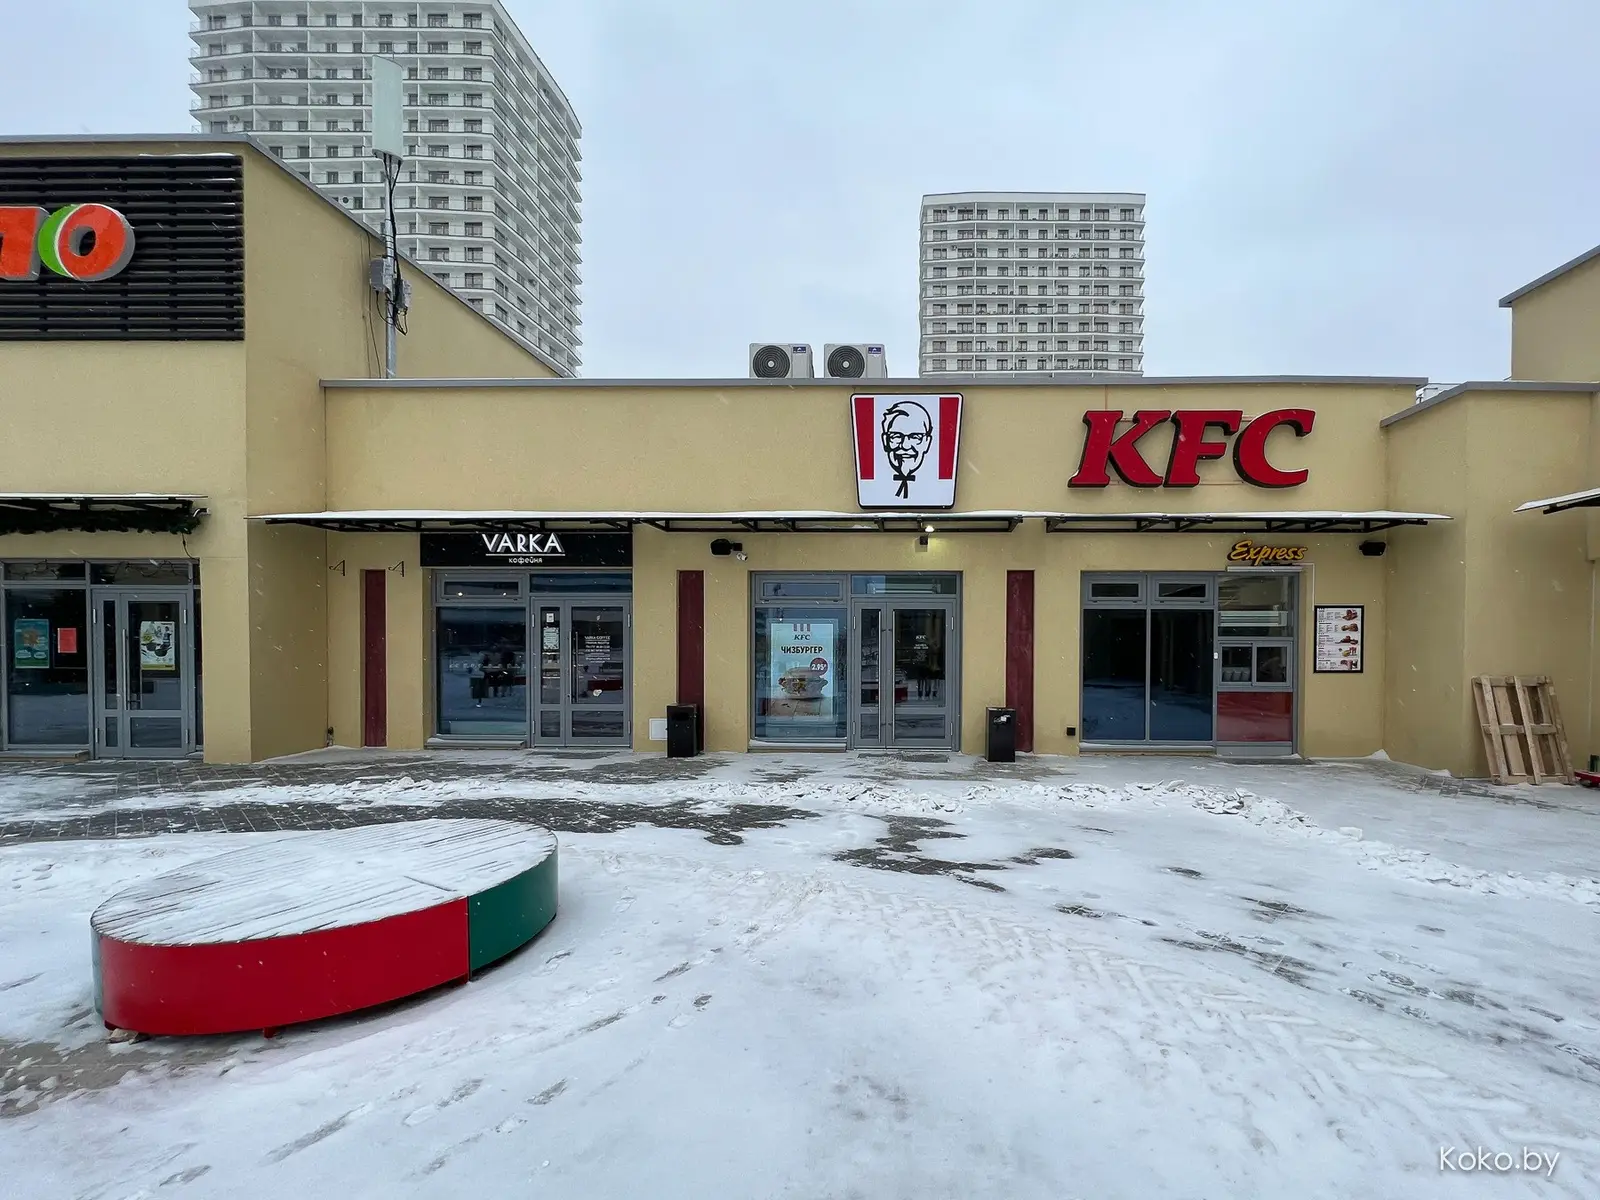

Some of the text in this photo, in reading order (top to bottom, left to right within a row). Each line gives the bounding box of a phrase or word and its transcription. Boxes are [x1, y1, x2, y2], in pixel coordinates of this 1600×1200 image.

[1067, 408, 1316, 488] KFC
[481, 532, 565, 553] VARKA
[1227, 539, 1308, 567] Express
[780, 645, 824, 654] ЧИЗБУРГЕР
